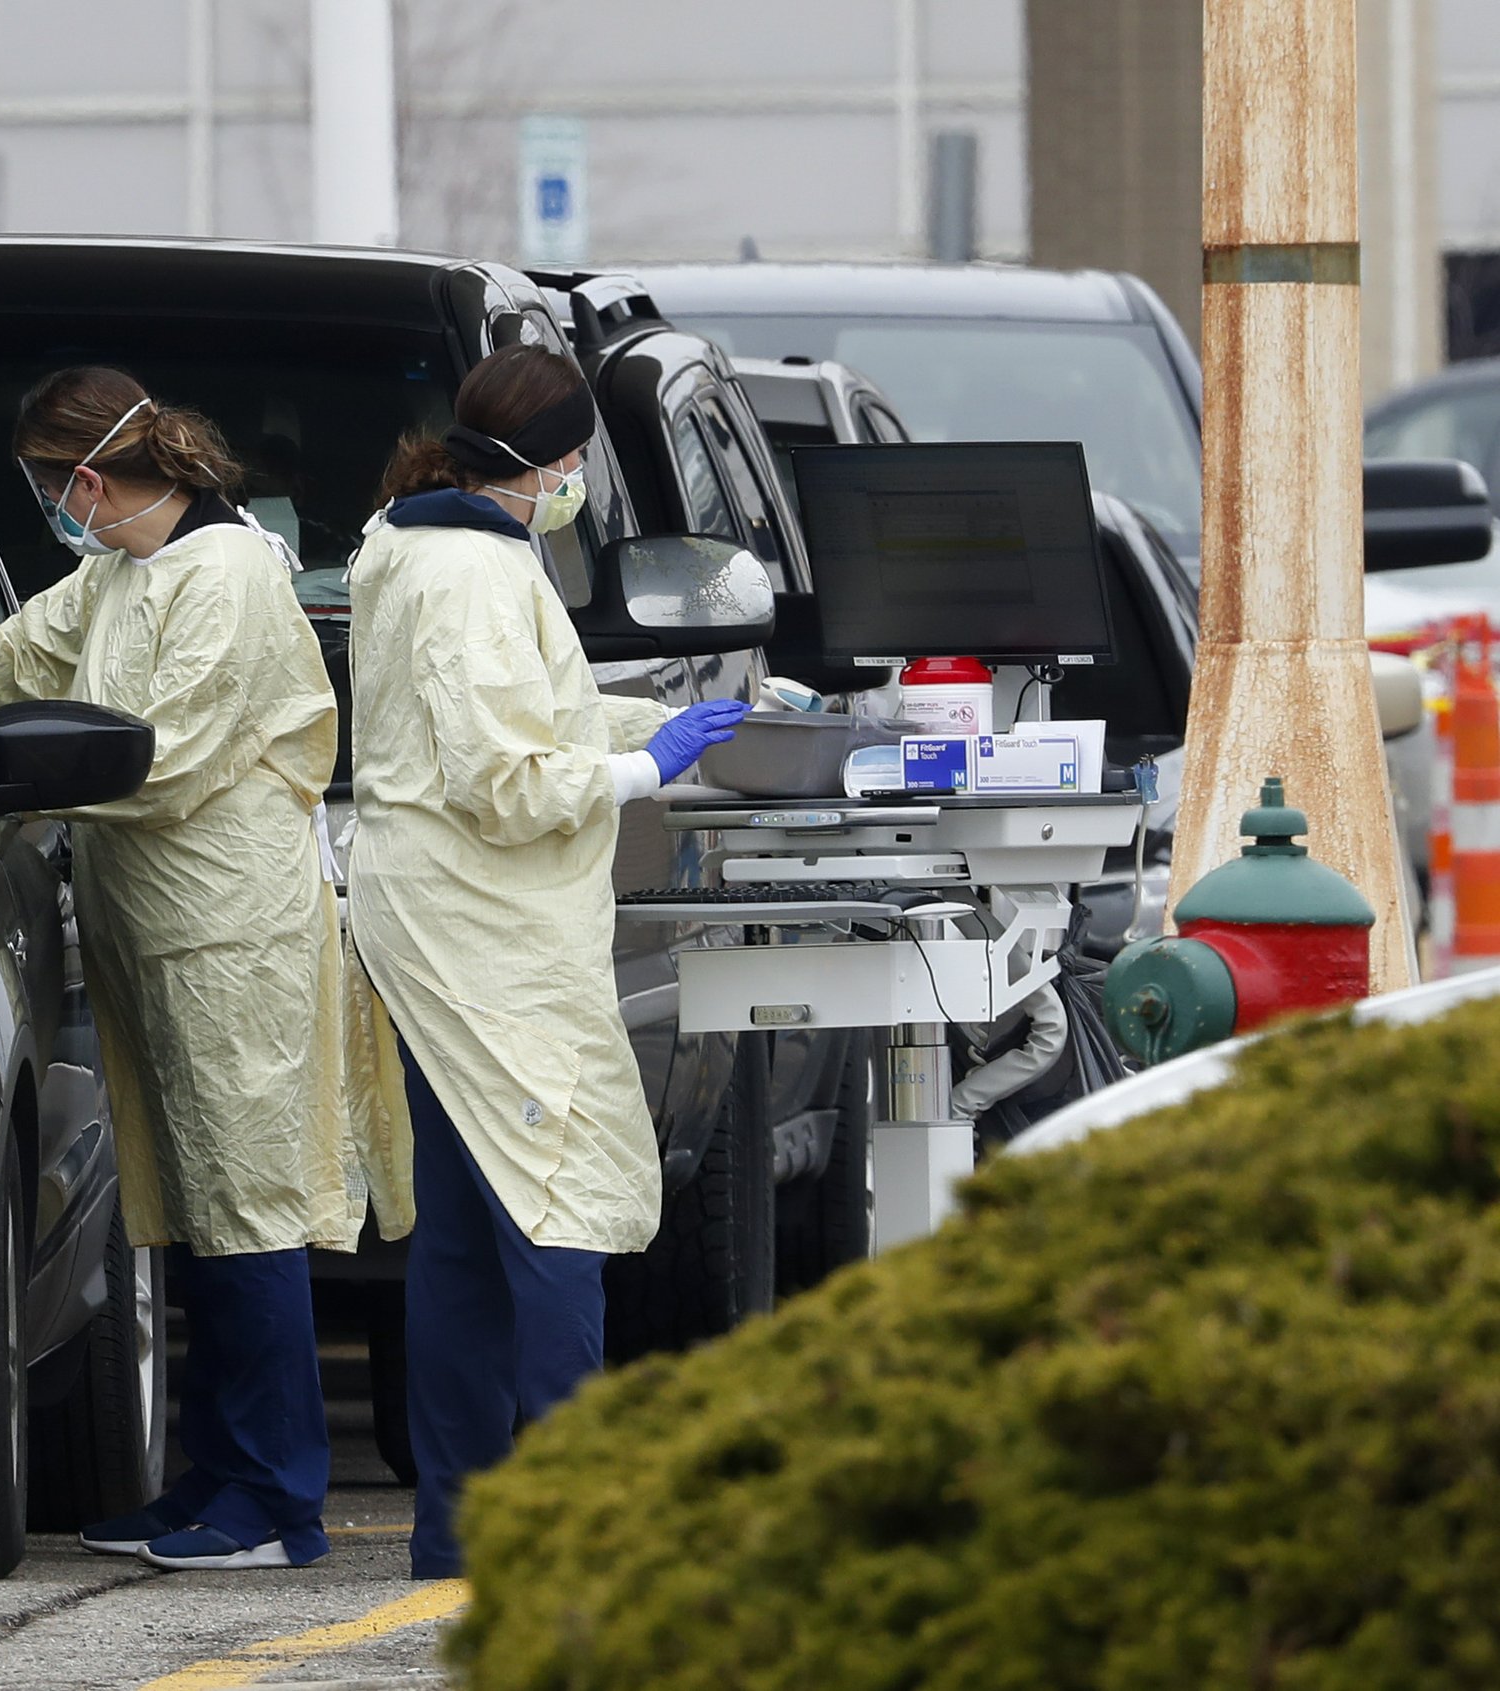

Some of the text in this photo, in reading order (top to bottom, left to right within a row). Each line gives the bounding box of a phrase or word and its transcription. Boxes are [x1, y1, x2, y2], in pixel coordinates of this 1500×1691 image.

[995, 739, 1038, 748] FitGuard Touch
[920, 752, 938, 760] Touch
[955, 772, 965, 785] M
[1063, 765, 1074, 782] M
